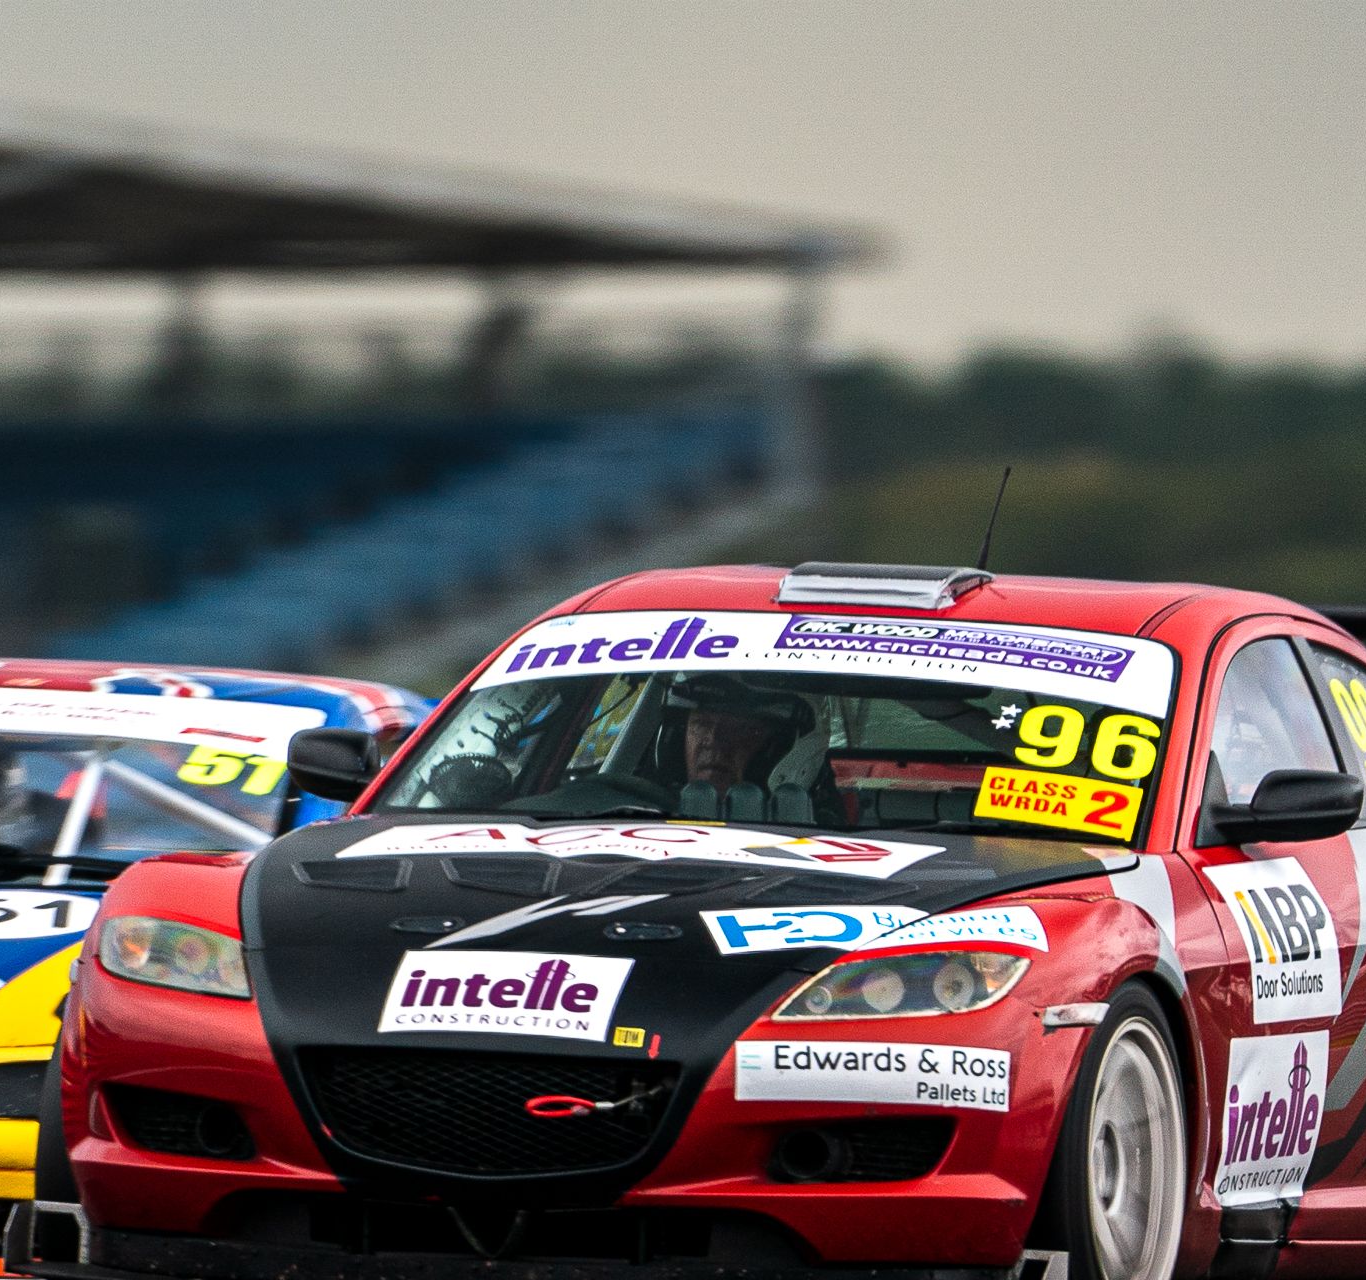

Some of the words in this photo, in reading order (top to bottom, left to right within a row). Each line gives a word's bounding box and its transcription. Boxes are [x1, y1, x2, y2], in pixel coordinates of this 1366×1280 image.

[505, 616, 740, 674] intelle
[785, 636, 1116, 681] www.cncheads.co.uk
[799, 621, 850, 634] RIC
[852, 622, 940, 639] WOOD
[942, 628, 1118, 659] MOTORSPORT
[744, 650, 980, 674] CONSTRUCTION
[1014, 704, 1161, 780] 96
[176, 743, 288, 796] 51
[989, 776, 1078, 800] CLASS
[1084, 790, 1130, 830] 2
[989, 792, 1068, 817] WRDA
[400, 958, 599, 1013] intelle
[1256, 973, 1279, 1000] Door
[1281, 969, 1324, 998] Solutions
[395, 1012, 590, 1032] CONSTRUCTION
[773, 1044, 907, 1073] Edwards
[917, 1048, 940, 1074] &
[951, 1050, 1007, 1080] Ross
[916, 1081, 977, 1103] Pallets
[982, 1087, 1007, 1106] Ltd
[1224, 1039, 1320, 1166] intelle
